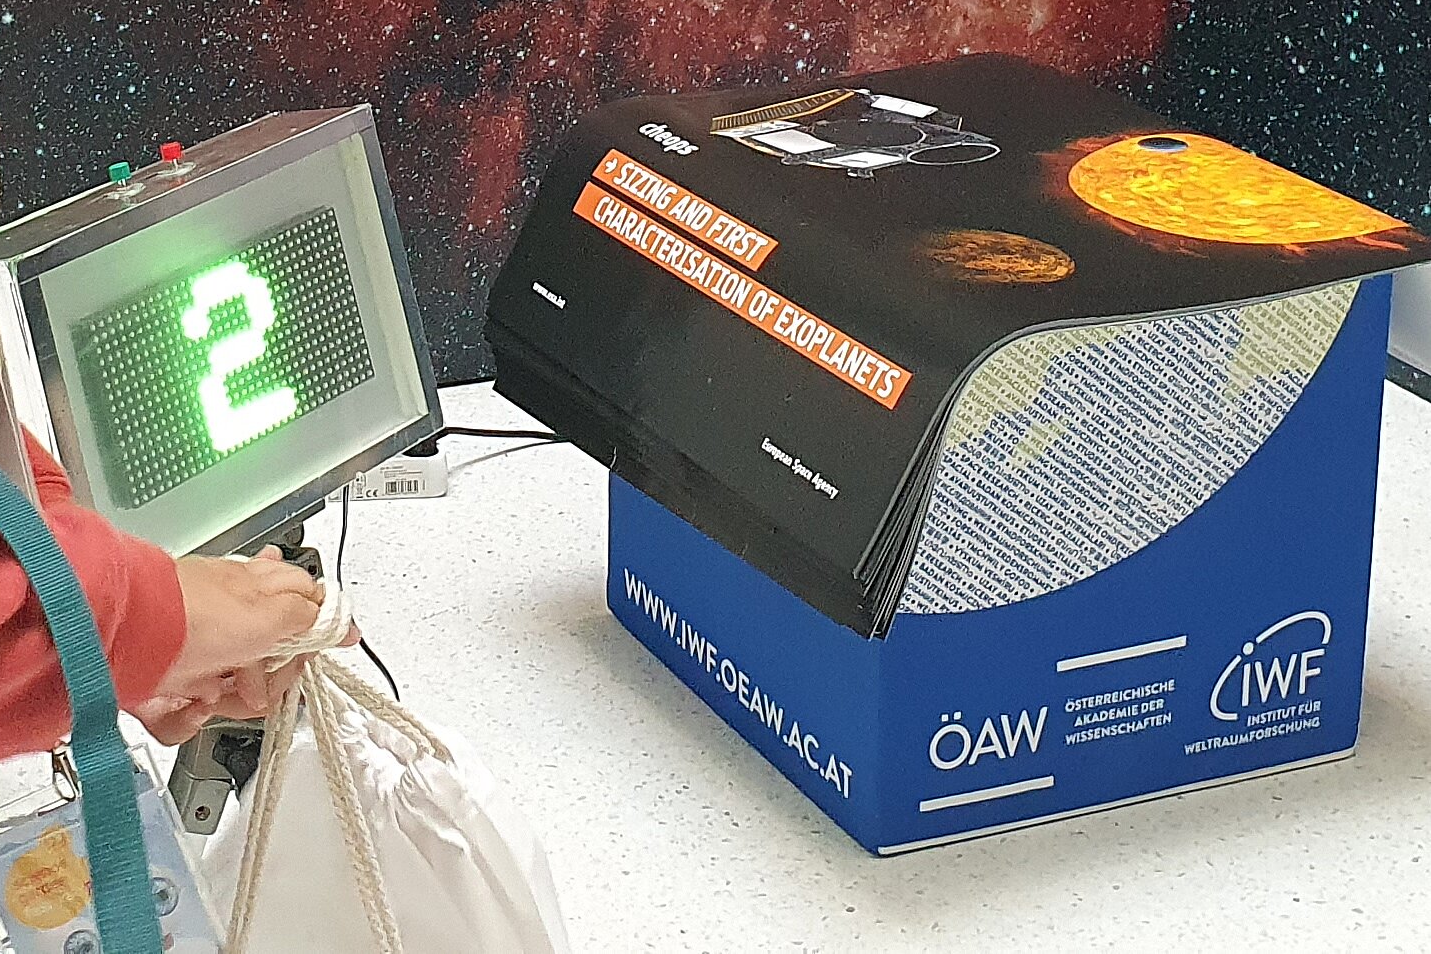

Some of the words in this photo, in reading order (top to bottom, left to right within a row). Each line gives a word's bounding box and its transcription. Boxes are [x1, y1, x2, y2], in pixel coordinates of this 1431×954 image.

[638, 121, 700, 157] cheops
[613, 161, 671, 211] SIZING
[669, 195, 712, 232] AND
[705, 216, 768, 263] FIRST
[592, 196, 747, 309] CHARACTERISATION
[748, 290, 781, 323] OF
[773, 305, 901, 399] EXOPLANETS
[181, 260, 297, 452] 2
[959, 452, 983, 473] SPACE
[981, 469, 1019, 500] RESEARCH
[624, 569, 853, 799] WWW.IWF.OEAW.AC.AT
[1065, 679, 1176, 713] ÖSTERREICHISCHE
[1065, 712, 1172, 745] WISSENSCHAFTEN
[1074, 702, 1139, 728] AKADEMIE
[1141, 698, 1165, 715] DER
[1247, 704, 1296, 728] INSTITUT
[1297, 699, 1321, 719] FÜR
[929, 707, 1048, 770] ÖAW
[1184, 717, 1320, 755] WELTRAUMFORSCHUNG
